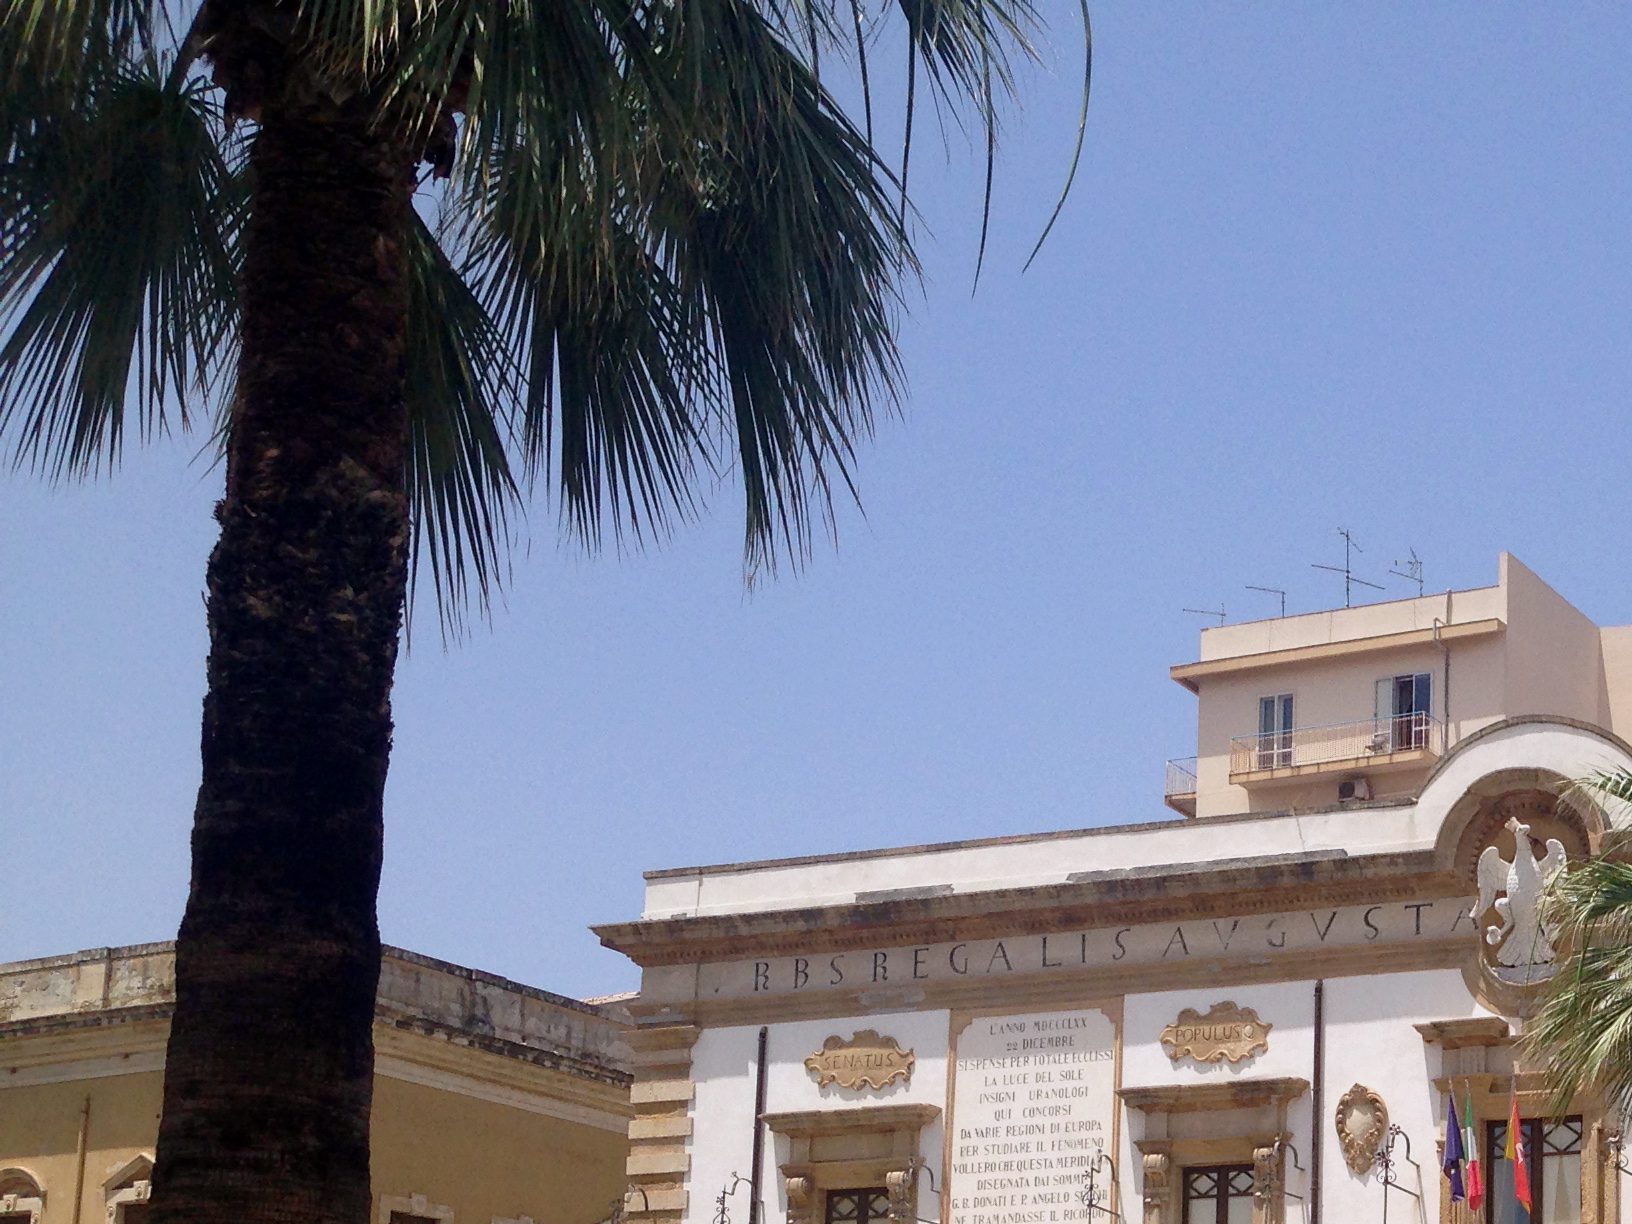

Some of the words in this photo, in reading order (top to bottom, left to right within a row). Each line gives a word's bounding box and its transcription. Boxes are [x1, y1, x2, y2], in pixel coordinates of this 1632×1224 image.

[753, 954, 845, 992] RBS
[871, 928, 1131, 983] REGALIS
[989, 1021, 1026, 1036] L'ANNO
[1033, 1016, 1088, 1032] MDCCCLXX
[1022, 1034, 1076, 1050] DICEMBRE
[824, 1052, 896, 1070] SENATUS
[1010, 1056, 1030, 1068] PER
[1033, 1051, 1070, 1067] TOTALE
[984, 1075, 998, 1088] LA
[1003, 1072, 1030, 1086] LUCE
[1035, 1071, 1055, 1084] DEL
[1059, 1068, 1085, 1082] SOLE
[979, 1091, 1016, 1105] INSIGNI
[1028, 1086, 1089, 1101] URANOLOGI
[994, 1108, 1012, 1122] QUI
[1022, 1104, 1072, 1119] CONCORSI
[960, 1128, 972, 1140] DA
[974, 1126, 1002, 1139] VARIE
[1005, 1123, 1046, 1138] REGIONI
[1050, 1122, 1060, 1134] DI
[1064, 1119, 1102, 1133] EUROPA
[959, 1145, 979, 1158] PER
[984, 1141, 1032, 1156] STUDIARE
[1036, 1140, 1047, 1153] IL
[1051, 1137, 1104, 1151] FENOMENO
[953, 1160, 996, 1175] VOLLERO
[999, 1159, 1016, 1172] CHE
[1016, 1157, 1054, 1172] QUESTA
[1055, 1154, 1110, 1169] MERIDIAA
[977, 1177, 1031, 1191] DISEGNATA
[1034, 1175, 1050, 1188] DAI
[951, 1198, 960, 1210] G.
[962, 1197, 970, 1209] B.
[973, 1193, 1007, 1209] DONATI
[1010, 1194, 1016, 1206] E
[1031, 1191, 1070, 1205] ANGELO
[1050, 1210, 1059, 1222] IL
